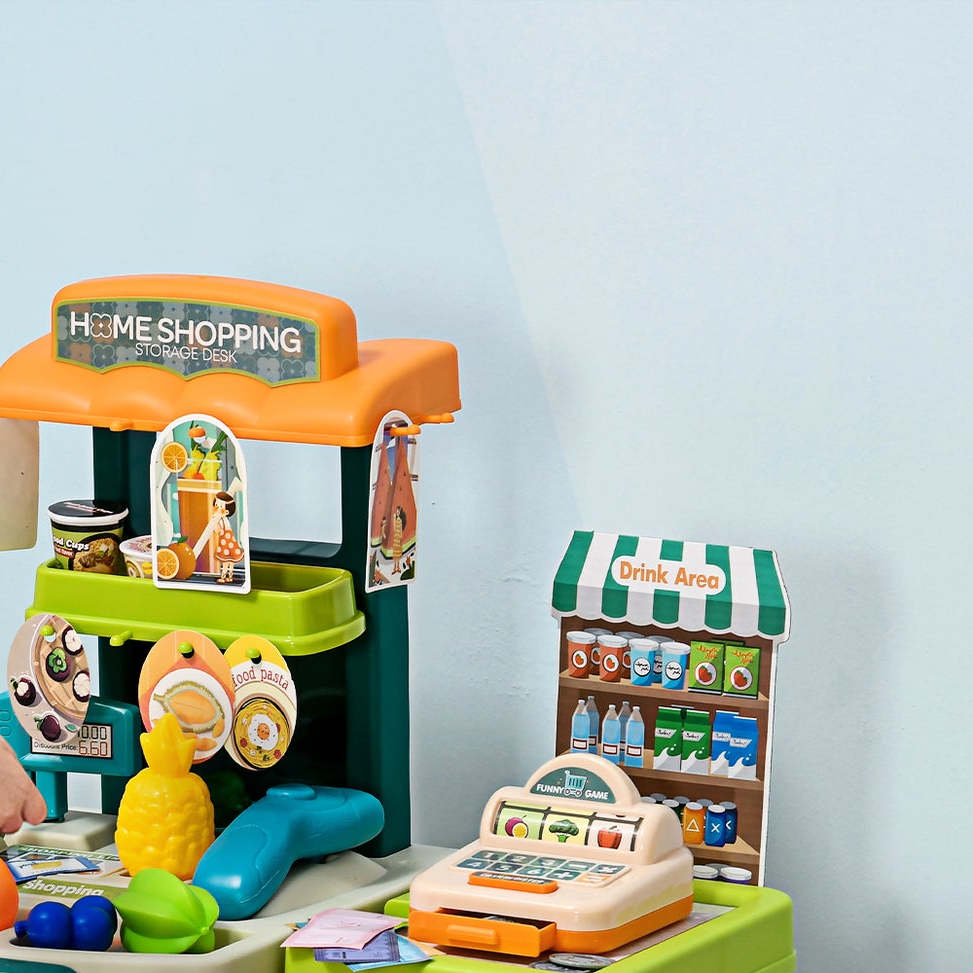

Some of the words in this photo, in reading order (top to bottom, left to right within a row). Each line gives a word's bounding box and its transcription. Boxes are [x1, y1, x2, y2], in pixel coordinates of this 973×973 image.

[158, 318, 301, 353] SHOPPING
[135, 343, 197, 359] STORAGE
[203, 349, 238, 364] DESK
[66, 539, 90, 551] Cups
[620, 561, 668, 584] Drink
[674, 567, 719, 589] Area
[260, 668, 289, 690] pasta
[79, 740, 108, 756] 6.60
[536, 783, 564, 794] FUNNY
[585, 790, 608, 800] GAME
